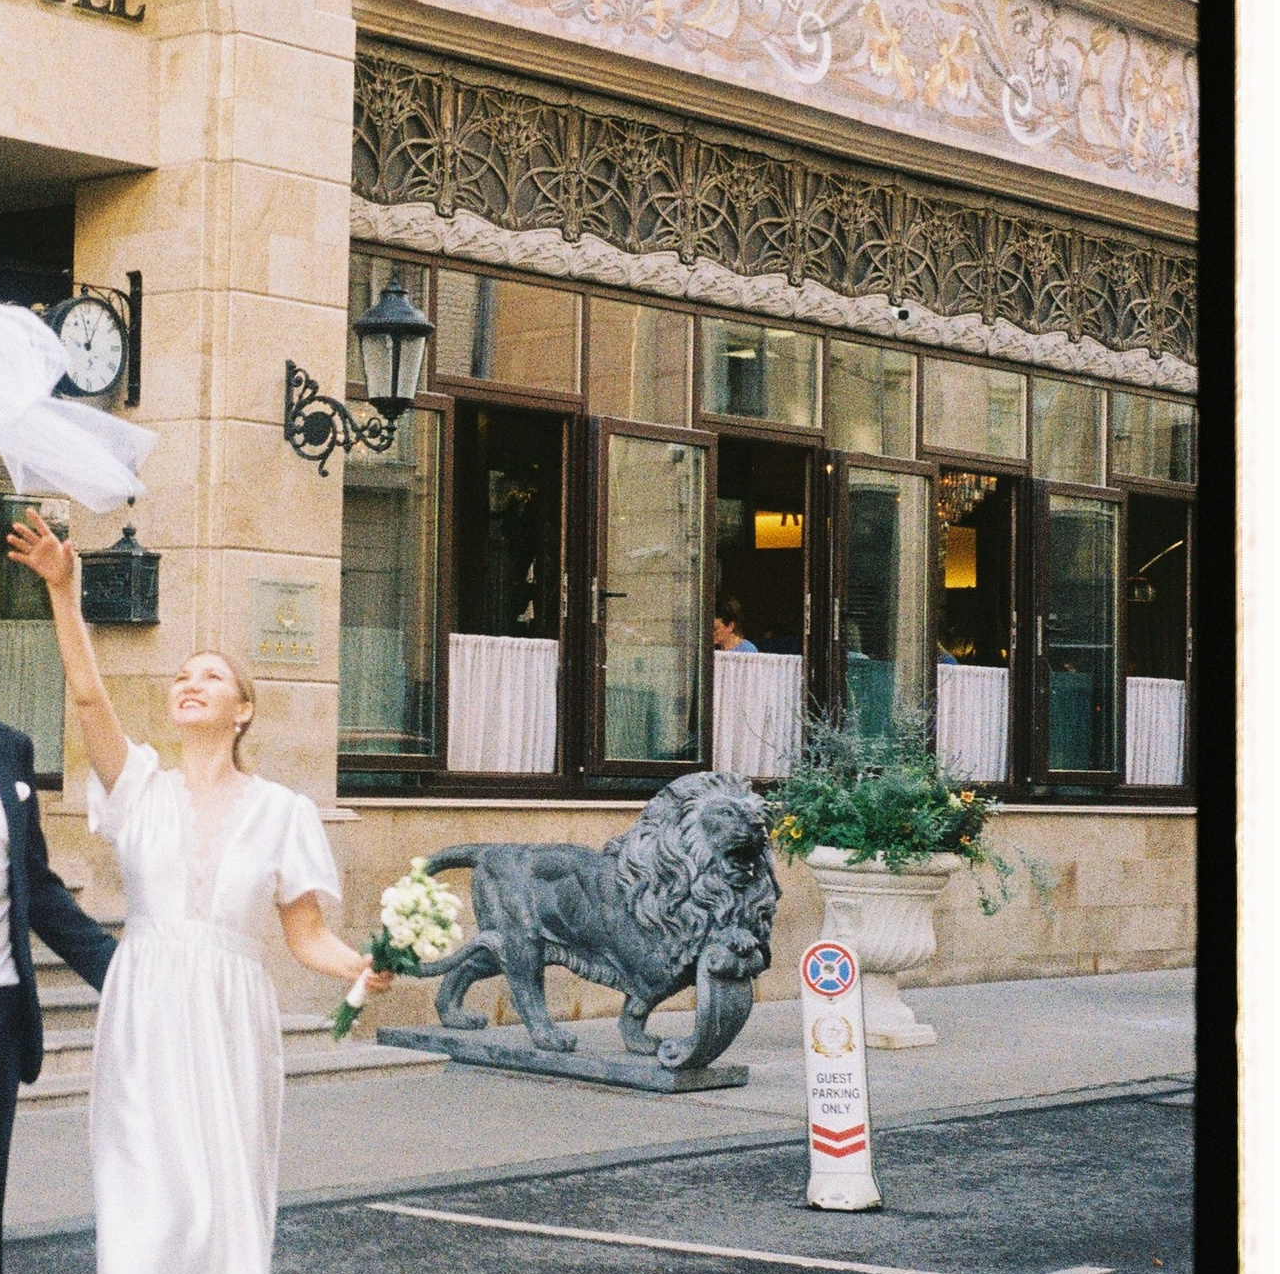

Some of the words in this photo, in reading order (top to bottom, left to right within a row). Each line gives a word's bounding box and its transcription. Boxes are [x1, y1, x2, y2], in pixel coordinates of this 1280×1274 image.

[816, 1072, 853, 1084] GUEST
[812, 1087, 860, 1099] PARKING
[821, 1103, 851, 1114] ONLY
